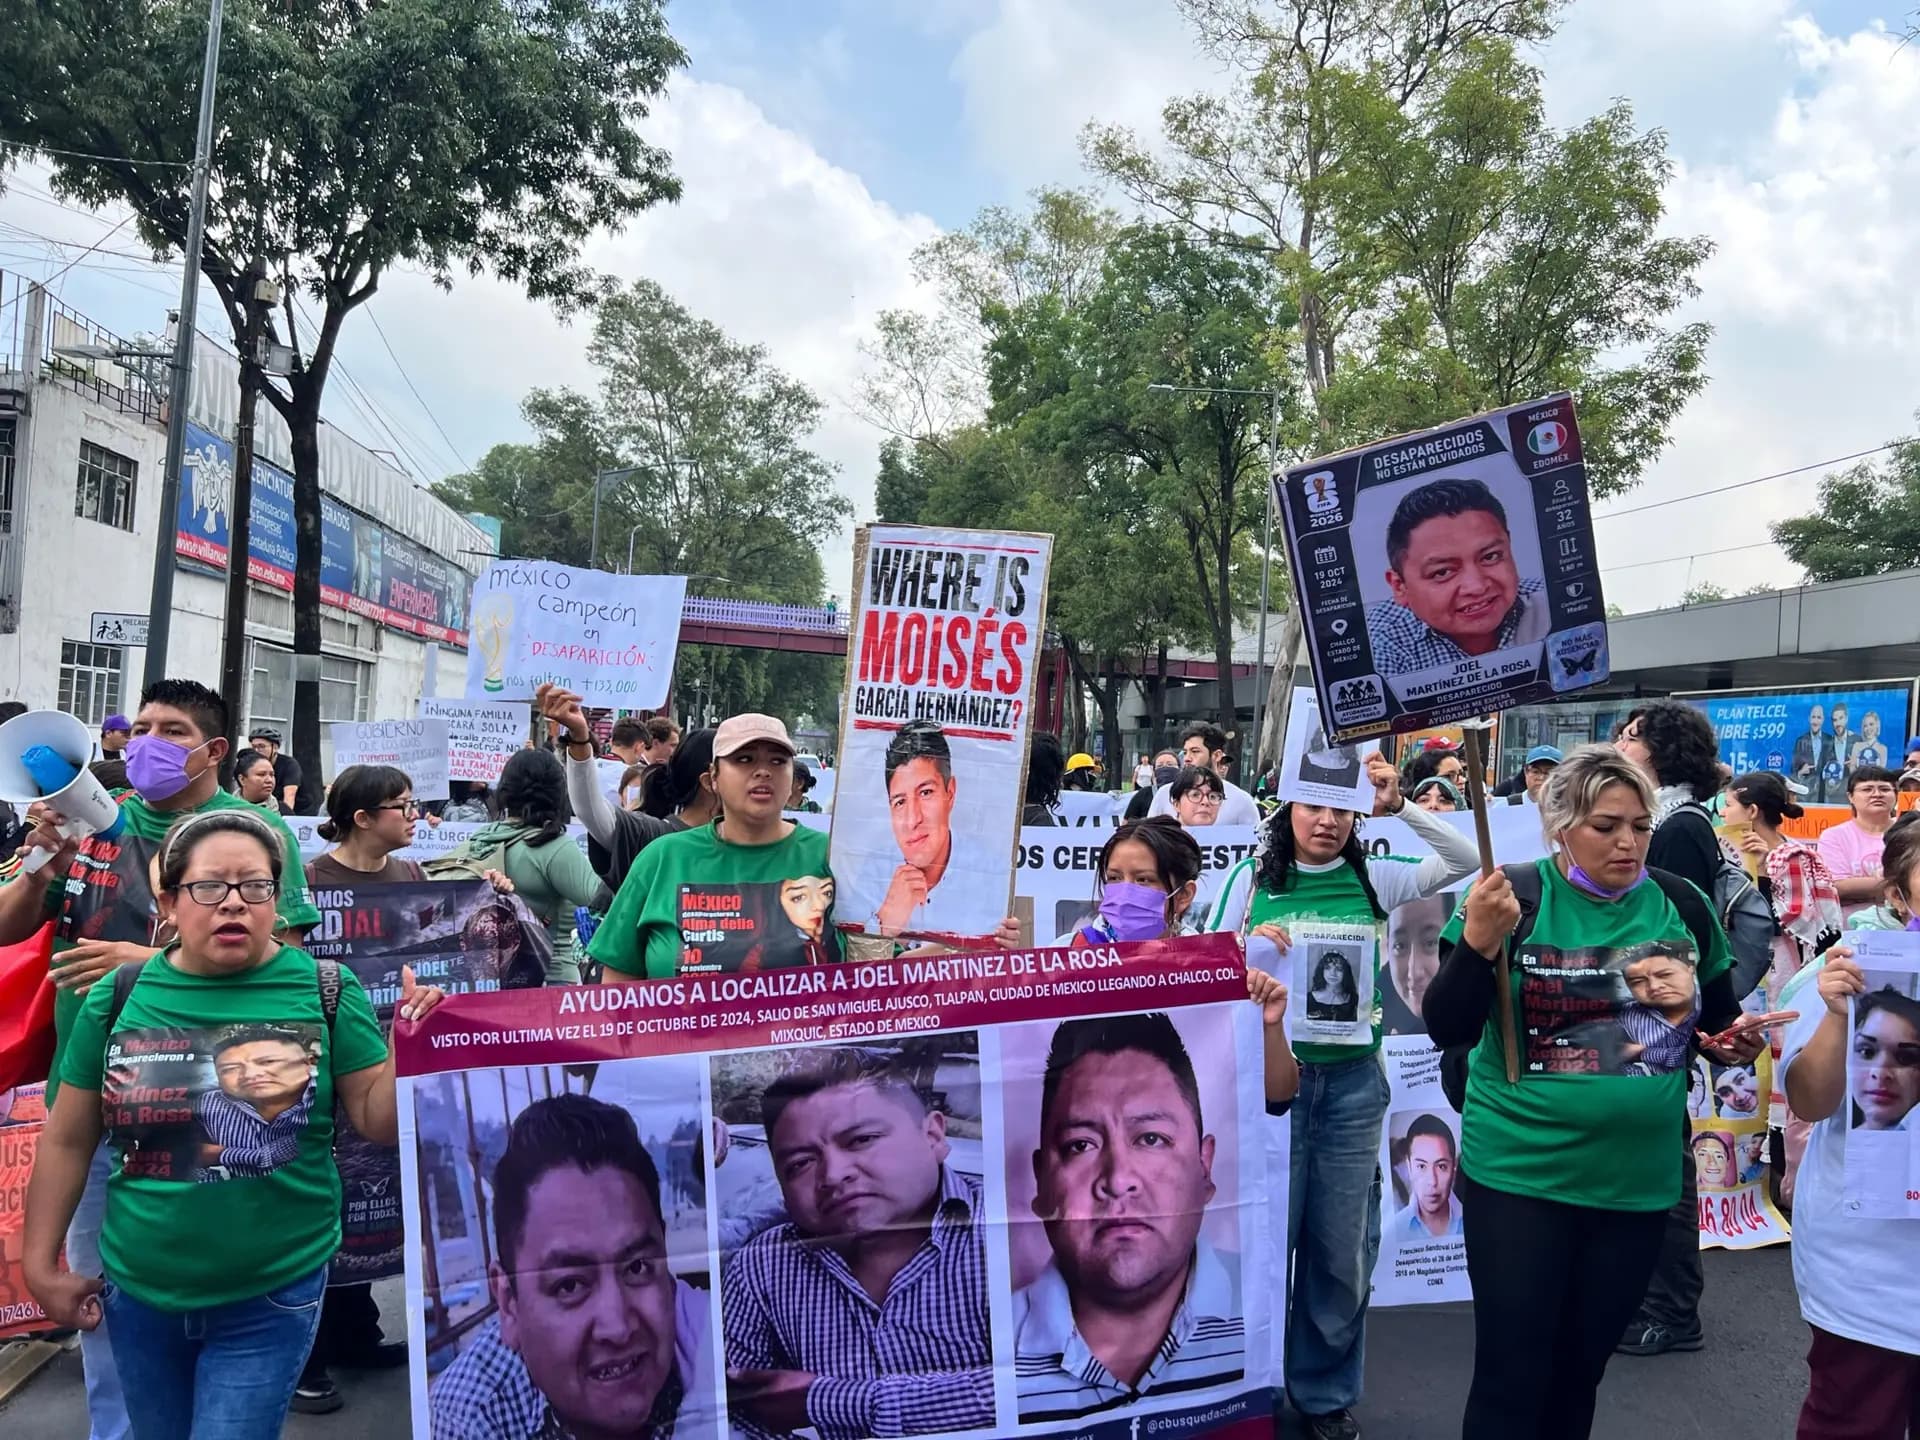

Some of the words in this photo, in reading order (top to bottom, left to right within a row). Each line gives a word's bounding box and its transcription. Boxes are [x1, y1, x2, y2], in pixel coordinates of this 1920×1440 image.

[1528, 408, 1559, 423] MÉXICO
[1374, 429, 1484, 469] DESAPARECIDOS
[1376, 468, 1391, 480] NO
[1393, 459, 1426, 475] ESTÁN
[1429, 442, 1486, 466] OLVIDADOS
[1310, 513, 1343, 527] 2026
[1556, 509, 1573, 521] 32
[1314, 570, 1324, 580] 19
[1327, 567, 1345, 577] OCT
[871, 548, 986, 612] WHERE
[994, 556, 1029, 617] IS
[1320, 578, 1342, 589] 2024
[584, 628, 600, 644] en
[1330, 638, 1355, 648] CHALCO
[532, 642, 646, 666] DESAPARICIÓN
[859, 607, 1027, 695] MOISÉS
[1327, 646, 1351, 656] ESTADO
[1556, 640, 1600, 656] AUSENCIAS
[1453, 660, 1482, 675] JOEL
[506, 676, 524, 686] nos
[1407, 677, 1464, 696] MARTÍNEZ
[1467, 672, 1481, 682] DE
[1485, 668, 1498, 678] LA
[1502, 660, 1531, 674] ROSA
[1437, 681, 1502, 703] DESAPARECIDO
[855, 685, 909, 718] GARCÍA
[915, 691, 1023, 729] HERNÁNDEZ?
[1442, 704, 1470, 714] FAMILIA
[1485, 693, 1510, 704] ESPERA
[1482, 699, 1516, 712] VOLVER
[475, 709, 513, 720] FAMILIA
[1717, 708, 1745, 720] PLAN
[1747, 704, 1788, 719] TELCEL
[1753, 722, 1785, 740] $599
[459, 750, 485, 760] VERDAD
[452, 759, 464, 767] LAS
[1730, 752, 1760, 775] 15%
[418, 829, 435, 840] DE
[682, 892, 742, 911] MÉXICO
[682, 918, 717, 930] Alma
[682, 929, 725, 942] Curtis
[1304, 932, 1366, 942] DESAPARECIDA
[346, 943, 353, 954] A
[683, 948, 702, 965] 10
[1522, 954, 1536, 965] En
[413, 960, 448, 977] JOEL
[558, 983, 686, 1014] AYUDANOS
[690, 982, 706, 1004] A
[711, 971, 827, 1002] LOCALIZAR
[832, 969, 848, 991] A
[852, 965, 899, 989] JOEL
[903, 956, 1007, 985] MARTINEZ
[1010, 954, 1037, 976] DE
[1040, 951, 1066, 973] LA
[1068, 947, 1123, 971] ROSA
[431, 1032, 470, 1048] VISTO
[473, 1031, 500, 1045] POR
[502, 1028, 553, 1044] ULTIMA
[556, 1025, 580, 1040] VEZ
[583, 1024, 597, 1038] EL
[600, 1022, 613, 1037] 19
[616, 1021, 633, 1035] DE
[637, 1015, 697, 1034] OCTUBRE
[701, 1014, 717, 1028] DE
[721, 1011, 754, 1027] 2024,
[757, 1007, 791, 1023] SALIO
[793, 1005, 809, 1019] DE
[811, 1002, 838, 1018] SAN
[838, 999, 883, 1016] MIGUEL
[885, 995, 933, 1011] AJUSCO,
[934, 989, 987, 1006] TLALPAN,
[989, 985, 1033, 1001] CIUDAD
[1036, 984, 1051, 998] DE
[1052, 980, 1096, 996] MEXICO
[1098, 975, 1156, 992] LLEGANDO
[1158, 974, 1169, 986] A
[1170, 969, 1214, 985] CHALCO,
[1216, 967, 1239, 981] COL.
[771, 1026, 827, 1044] MIXQUIC,
[829, 1021, 875, 1038] ESTADO
[877, 1019, 893, 1032] DE
[895, 1015, 940, 1031] MEXICO
[108, 1044, 121, 1056] En
[124, 1039, 191, 1052] México
[1556, 1038, 1568, 1046] de
[186, 1053, 195, 1061] a
[1530, 1062, 1543, 1070] del
[1547, 1060, 1600, 1072] 2024
[138, 1106, 192, 1124] Rosa
[349, 1201, 367, 1212] POR
[1721, 1196, 1743, 1237] 80
[1741, 1189, 1768, 1230] 04
[348, 1212, 367, 1223] POR
[1400, 1247, 1424, 1255] Francisco
[1395, 1257, 1431, 1266] Desaparecido
[1416, 1267, 1445, 1276] Magdalena
[1427, 1278, 1443, 1286] CDMX
[1147, 1400, 1247, 1434] @cbusquedacdmx
